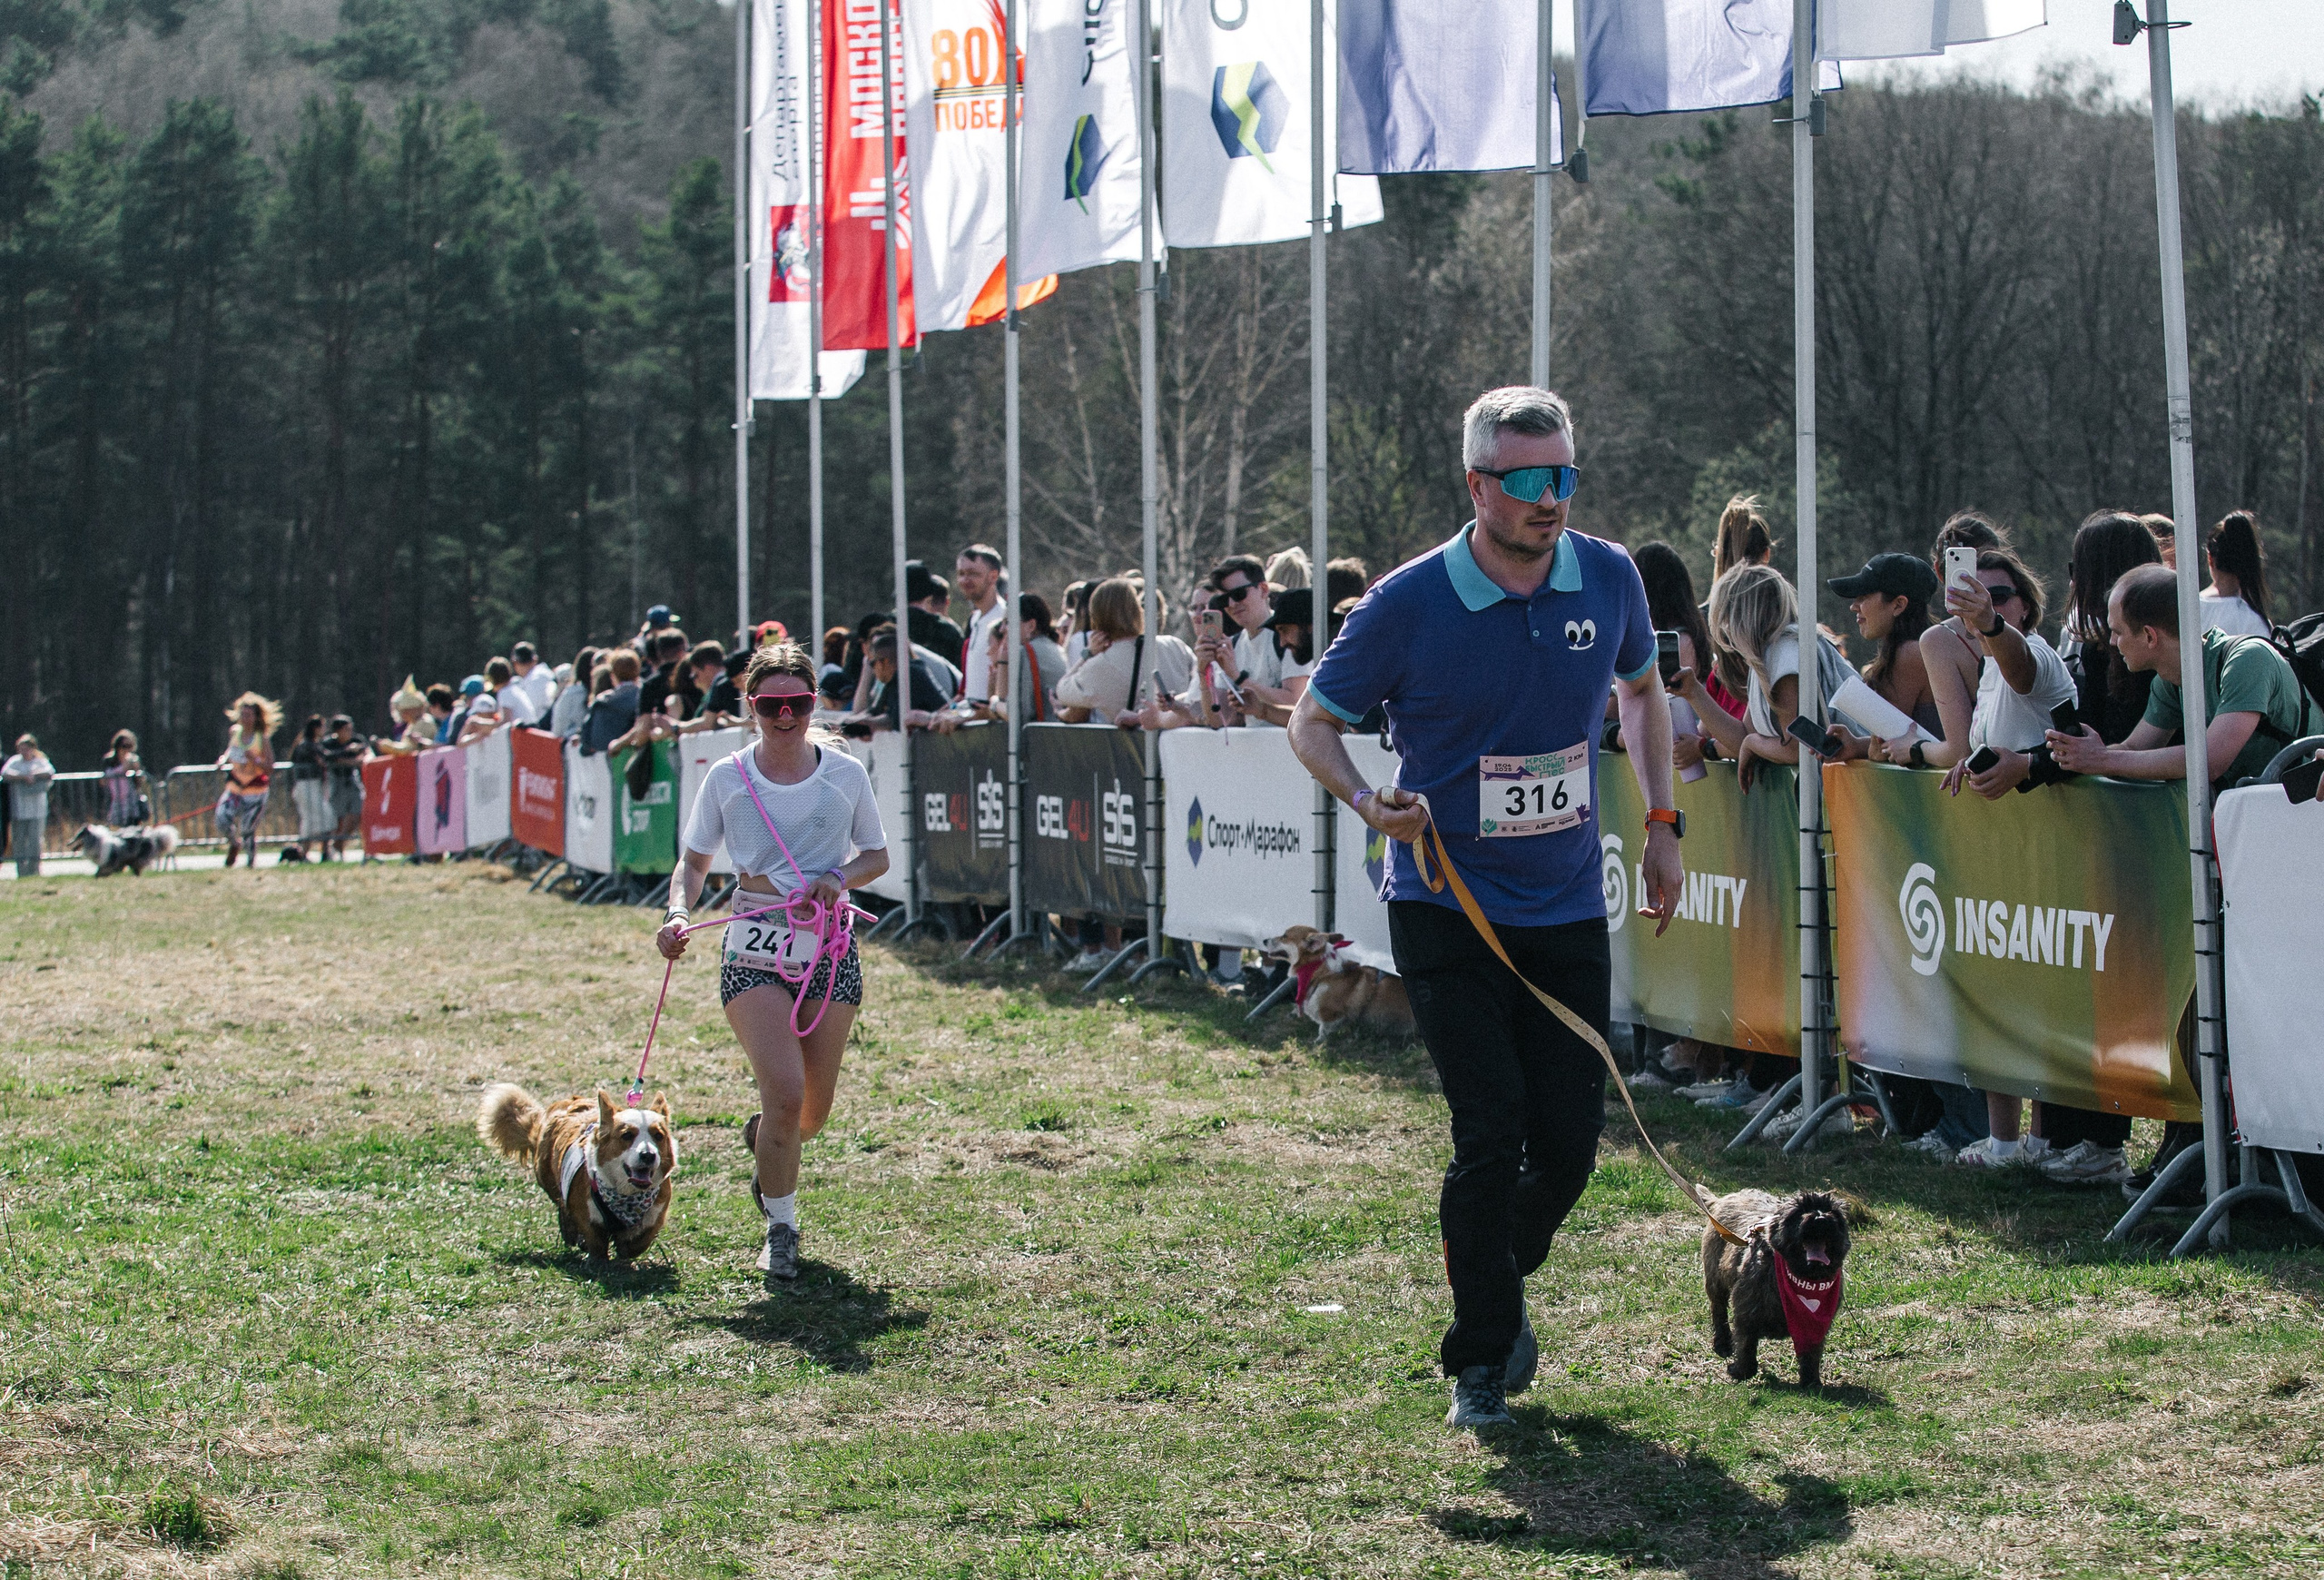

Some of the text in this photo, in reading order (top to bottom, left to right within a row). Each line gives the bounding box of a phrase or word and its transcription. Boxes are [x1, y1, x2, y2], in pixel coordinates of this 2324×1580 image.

[931, 27, 989, 88] 80
[1568, 755, 1573, 764] 2
[1504, 779, 1569, 816] 316
[1955, 896, 2115, 972] INSANITY
